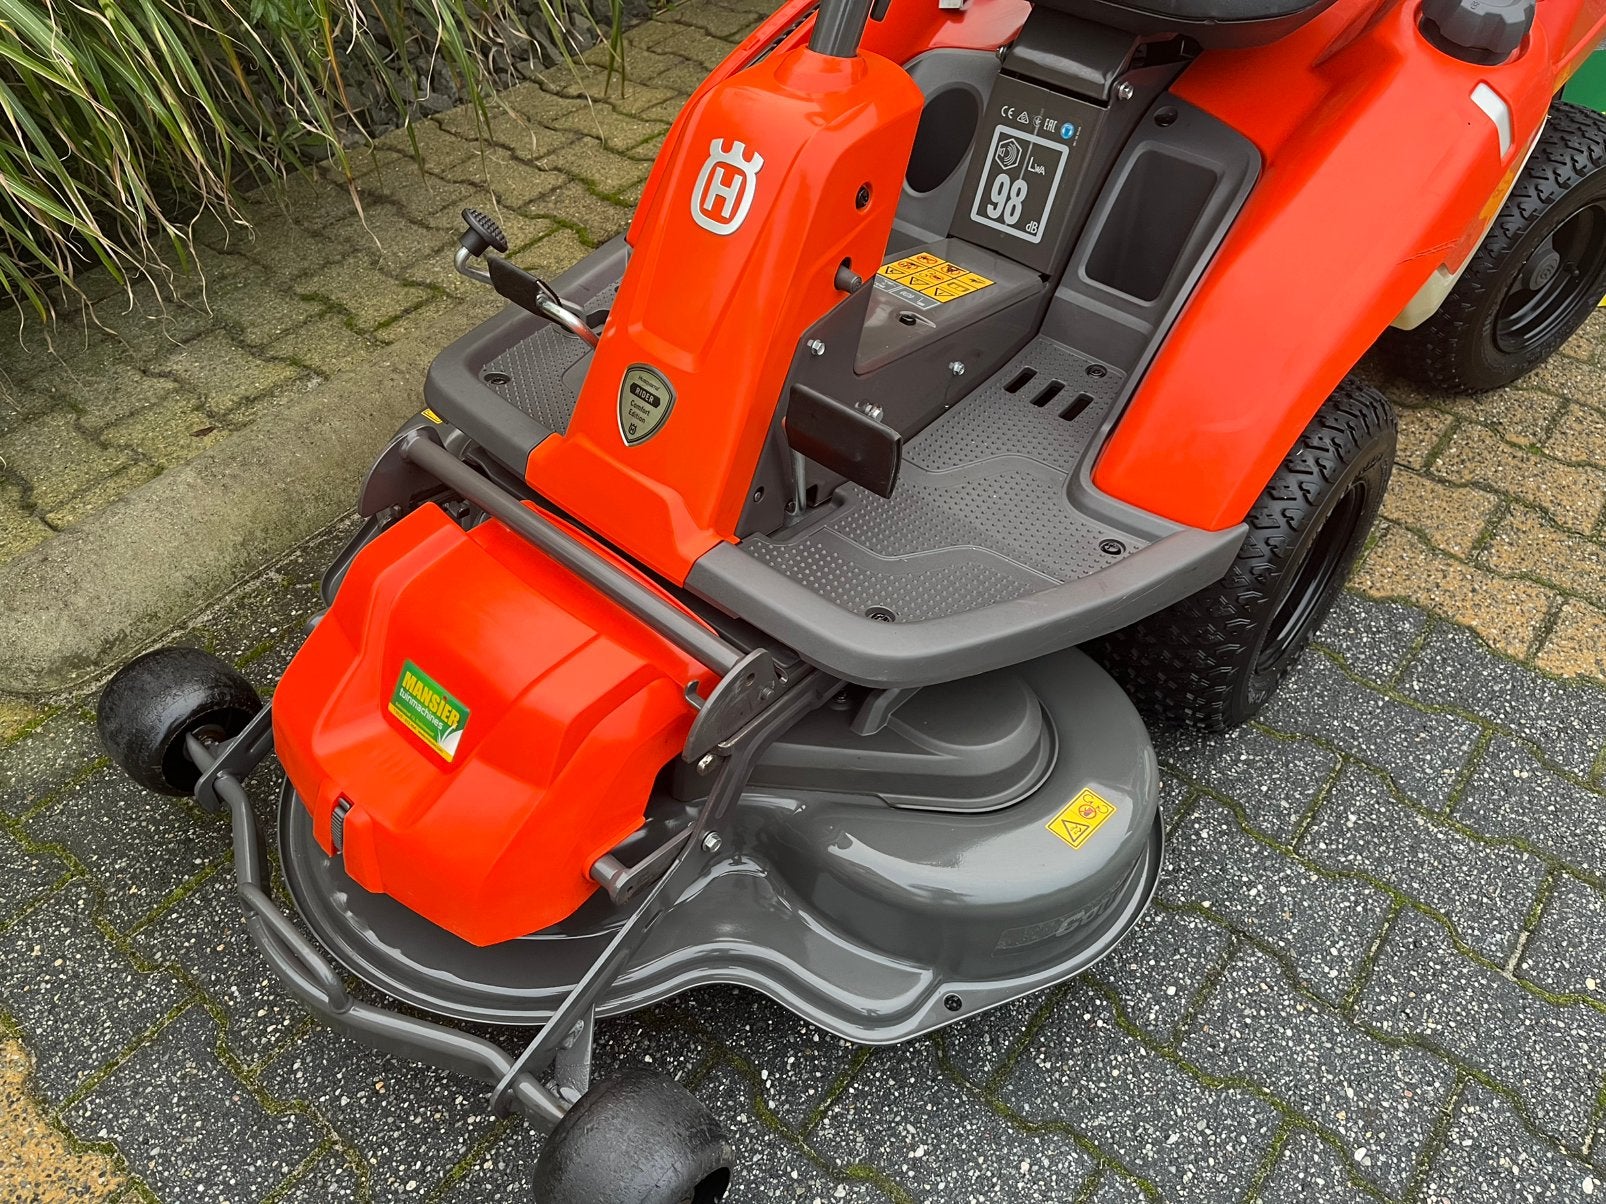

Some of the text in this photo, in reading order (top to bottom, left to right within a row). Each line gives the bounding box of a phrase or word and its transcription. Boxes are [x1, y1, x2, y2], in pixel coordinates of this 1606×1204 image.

[986, 173, 1028, 225] 98
[1025, 220, 1039, 234] dB
[635, 387, 655, 404] RIDER
[399, 687, 444, 730] tuinmachines
